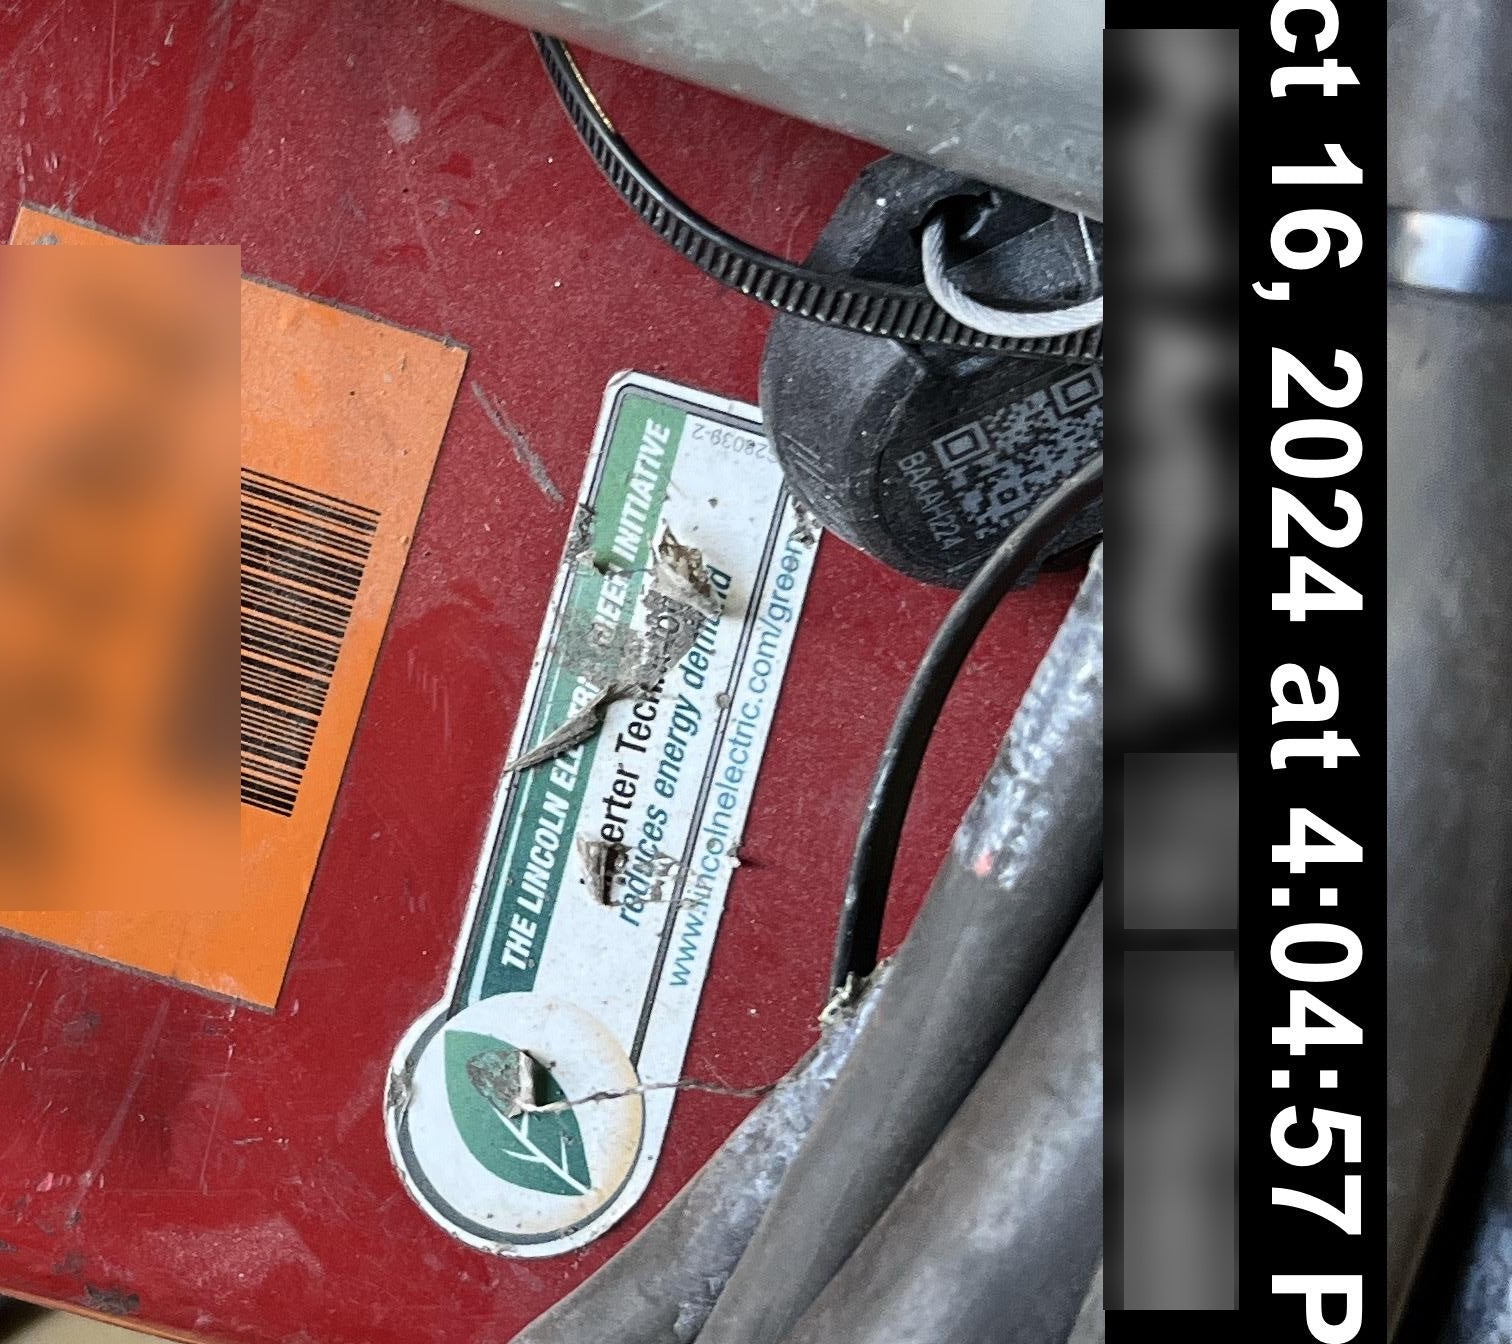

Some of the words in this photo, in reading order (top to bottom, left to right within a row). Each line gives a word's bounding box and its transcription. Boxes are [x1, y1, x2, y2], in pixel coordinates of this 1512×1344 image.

[516, 788, 579, 916] LINCOLN
[603, 416, 681, 566] INITIATIVE
[613, 801, 670, 928] reduces
[648, 692, 703, 801] energy
[677, 564, 733, 692] demd
